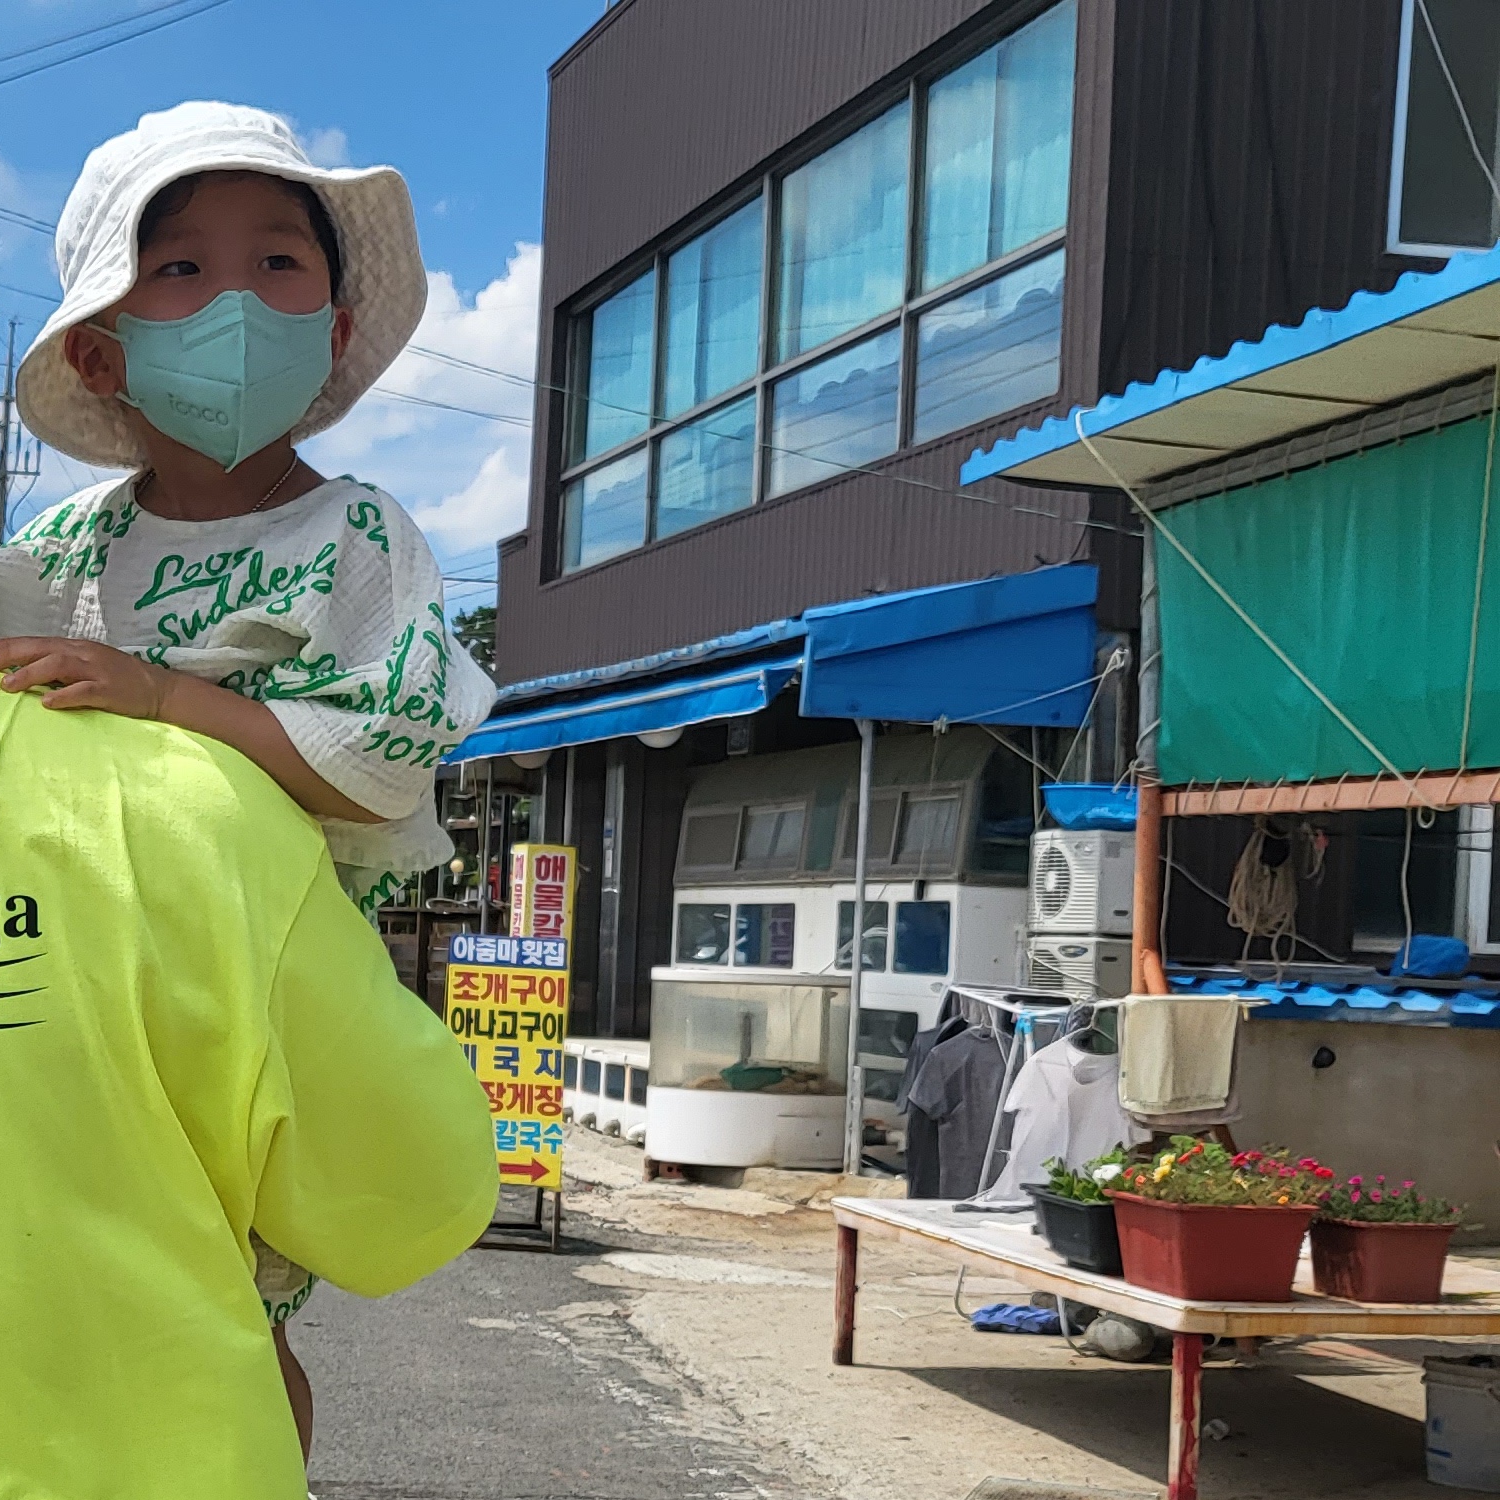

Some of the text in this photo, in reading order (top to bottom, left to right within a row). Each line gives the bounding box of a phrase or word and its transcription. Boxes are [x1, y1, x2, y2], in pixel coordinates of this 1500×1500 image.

[452, 971, 566, 1009] 조개구이
[450, 1006, 564, 1045] 아나고구이
[495, 1119, 563, 1155] 칼국수
